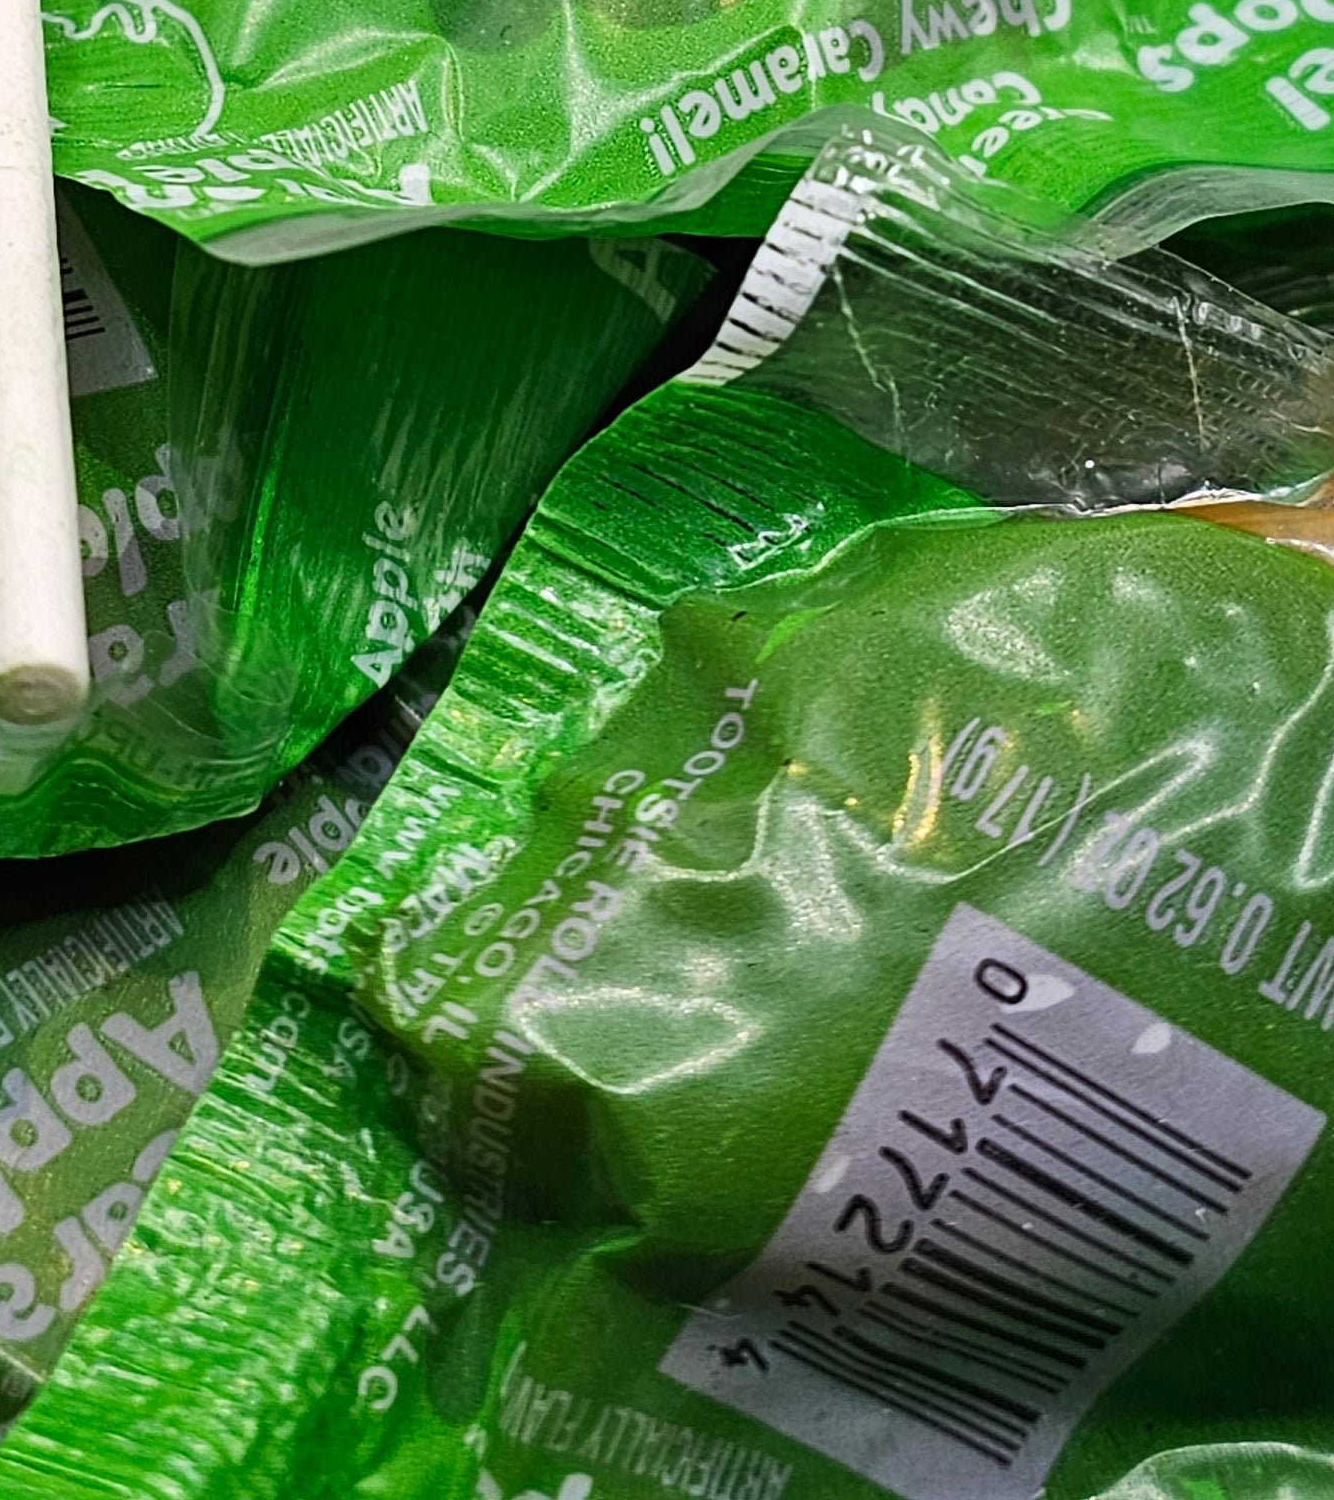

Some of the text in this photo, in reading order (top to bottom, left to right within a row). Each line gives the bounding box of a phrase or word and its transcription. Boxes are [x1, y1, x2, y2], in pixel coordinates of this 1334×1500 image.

[639, 20, 885, 176] Caramel!
[350, 499, 424, 689] Apple
[606, 679, 759, 876] TOOTSIE
[457, 768, 647, 985] CHICAGO,
[1145, 849, 1274, 975] 0.62
[0, 900, 184, 1026] ARTIFICIALLY
[421, 1000, 480, 1045] IL
[974, 957, 1029, 1005] 0
[772, 1038, 1010, 1316] 717214
[357, 1303, 439, 1411] LLC
[715, 1335, 772, 1376] 4
